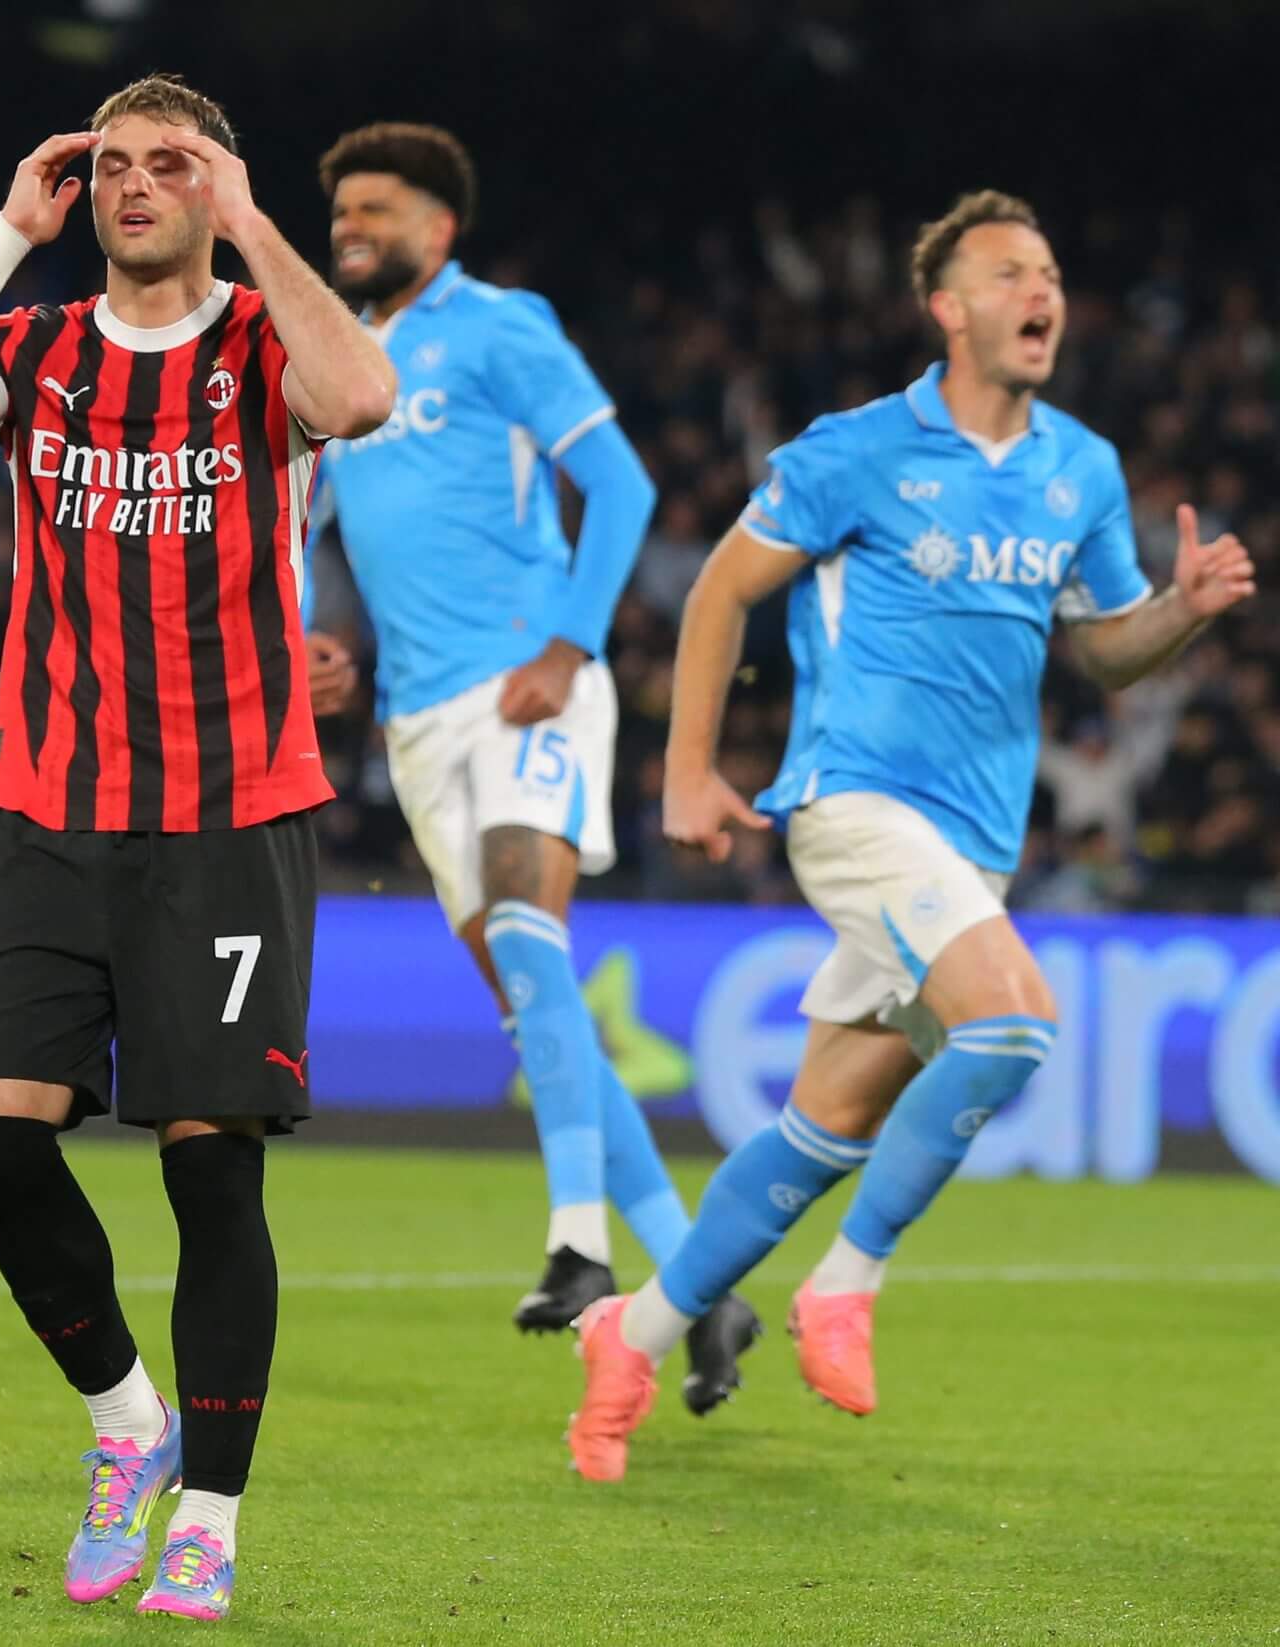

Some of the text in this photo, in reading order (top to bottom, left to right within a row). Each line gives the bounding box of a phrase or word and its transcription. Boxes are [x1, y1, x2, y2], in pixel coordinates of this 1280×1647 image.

[30, 429, 243, 491] Emirates
[55, 489, 213, 536] FLY BETTER
[514, 725, 568, 785] 15
[214, 935, 261, 1023] 7
